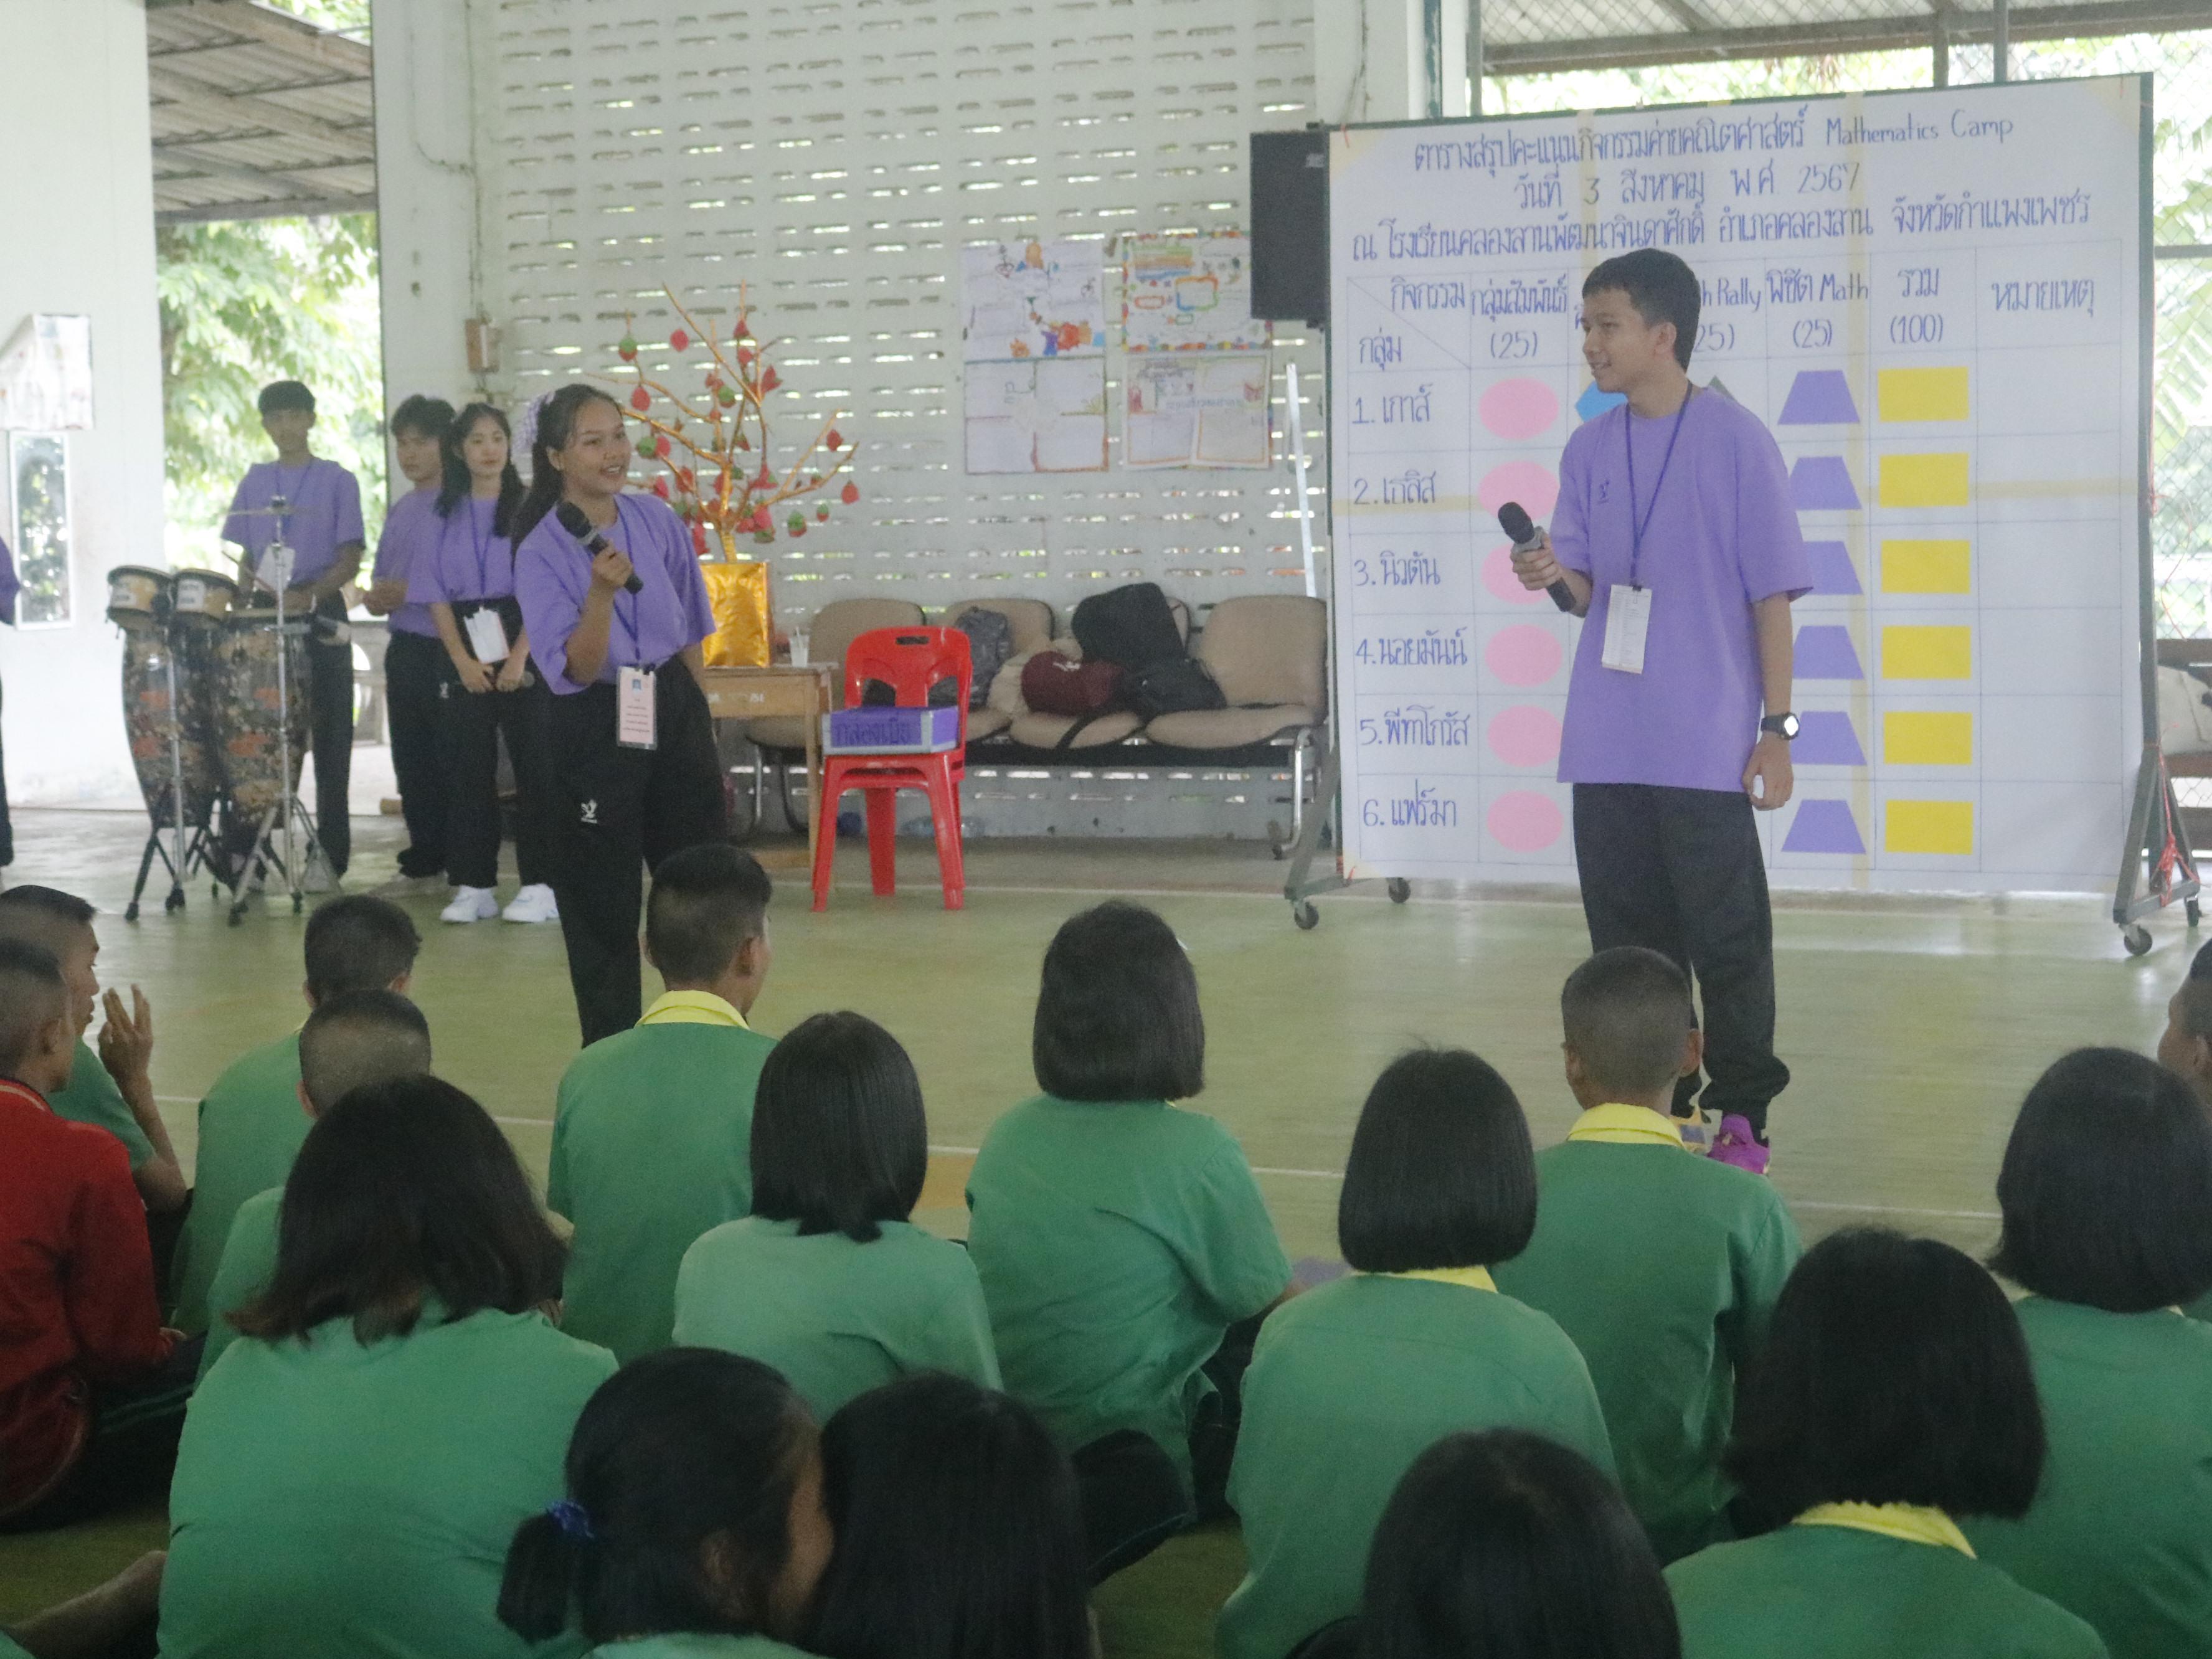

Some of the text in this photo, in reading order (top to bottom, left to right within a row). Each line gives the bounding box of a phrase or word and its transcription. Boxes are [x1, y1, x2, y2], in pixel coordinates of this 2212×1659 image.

[1415, 106, 2014, 178] ตารางสรุปคะแนนกิจกรรมค่ายคณิตศาสตร์ Mathematics Camp
[1514, 163, 1562, 209] วันที่
[1583, 177, 1601, 205] 3
[1620, 168, 1705, 204] สิงหาคม
[1797, 161, 1861, 194] 2567
[1352, 232, 1378, 262] ณ
[1719, 205, 1874, 243] อำเภอคลองลาน
[1891, 187, 2091, 234] จังหวัดกำแพงเพชร
[1391, 275, 1466, 312] กิจกรรม
[1470, 273, 1567, 323] กลุ่มสัมพันธ์
[1717, 276, 1762, 313] Rally
[1765, 267, 1869, 304] พิชิต Math
[1898, 267, 1940, 298] รวม
[1991, 278, 2094, 318] หมายเหตุ
[1490, 329, 1538, 359] (25)
[1691, 321, 1736, 353] 25)
[1793, 318, 1833, 349] (25)
[1889, 313, 1944, 344] (100)
[1359, 326, 1402, 372] กลุ่ม
